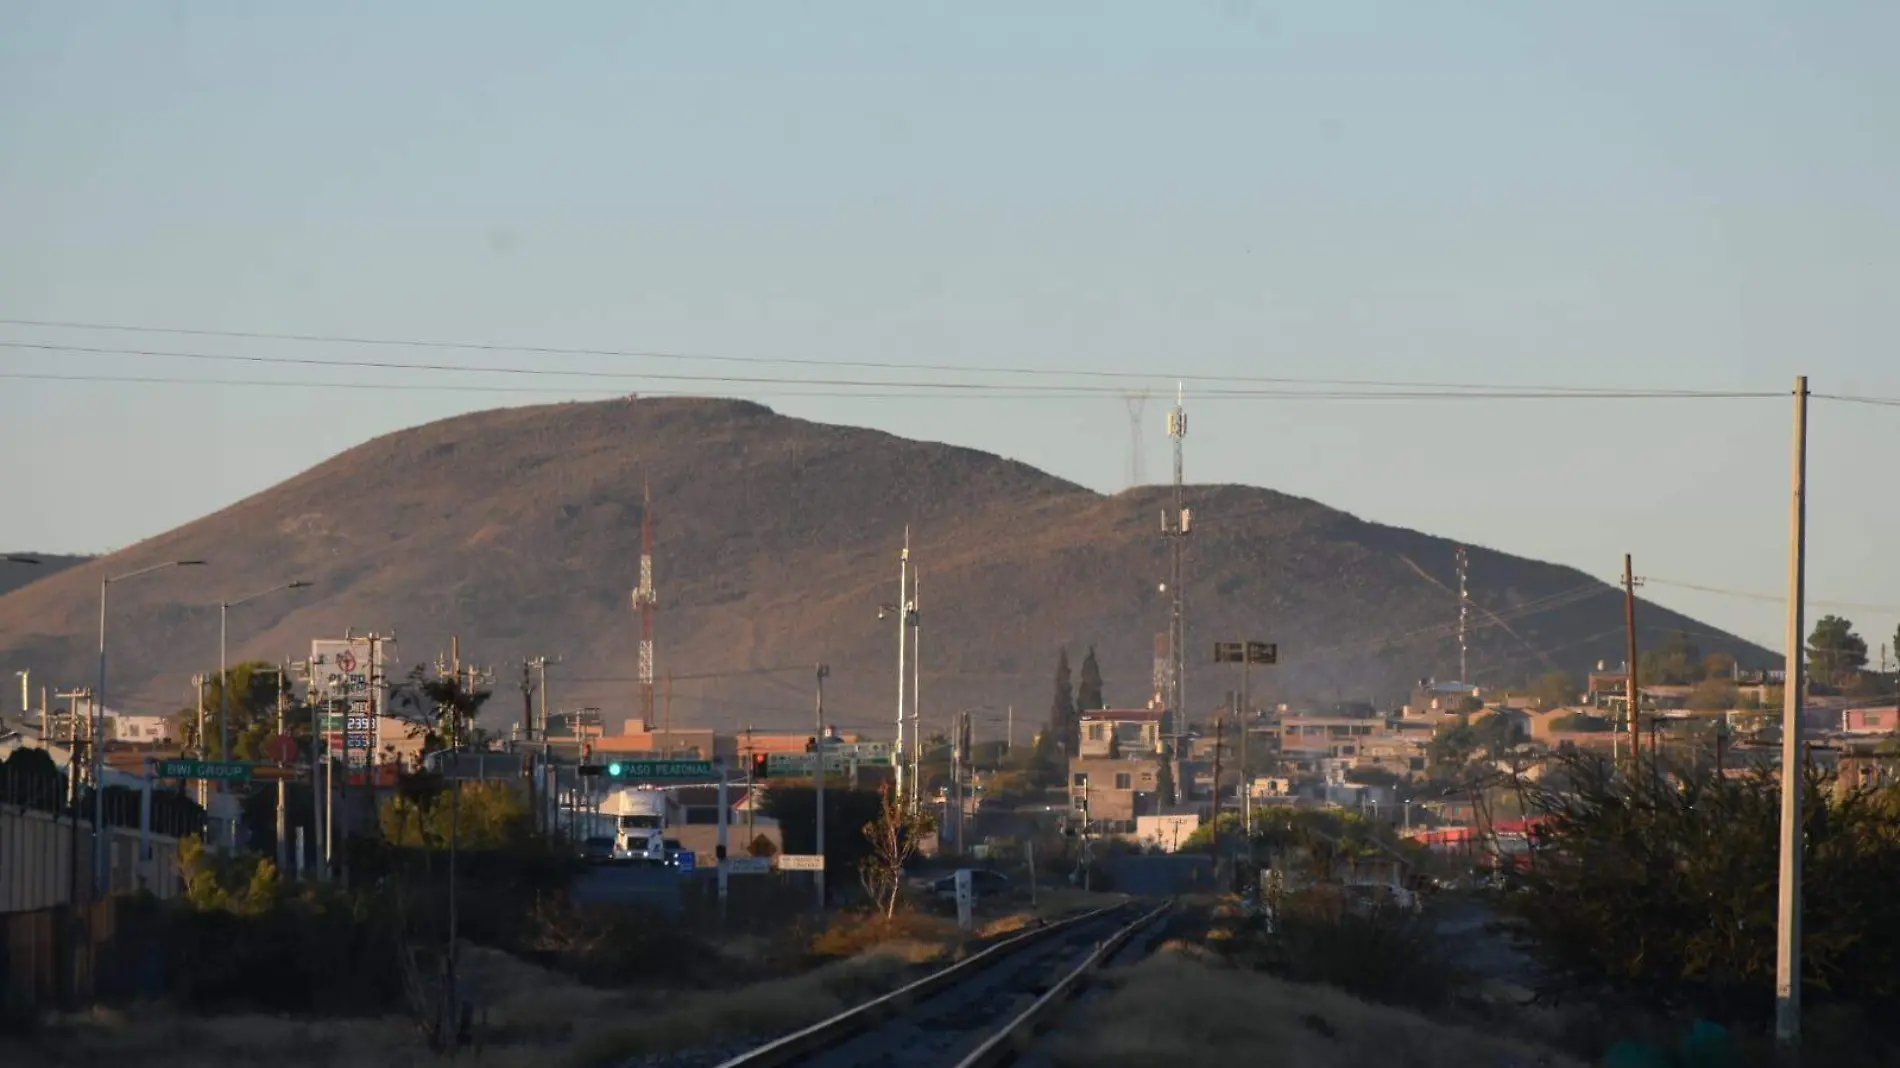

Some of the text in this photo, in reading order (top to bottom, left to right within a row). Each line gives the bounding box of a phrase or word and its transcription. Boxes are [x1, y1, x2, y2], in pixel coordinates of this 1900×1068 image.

[167, 763, 243, 777] BWI GROUP
[623, 763, 711, 777] PASO PEATONAL
